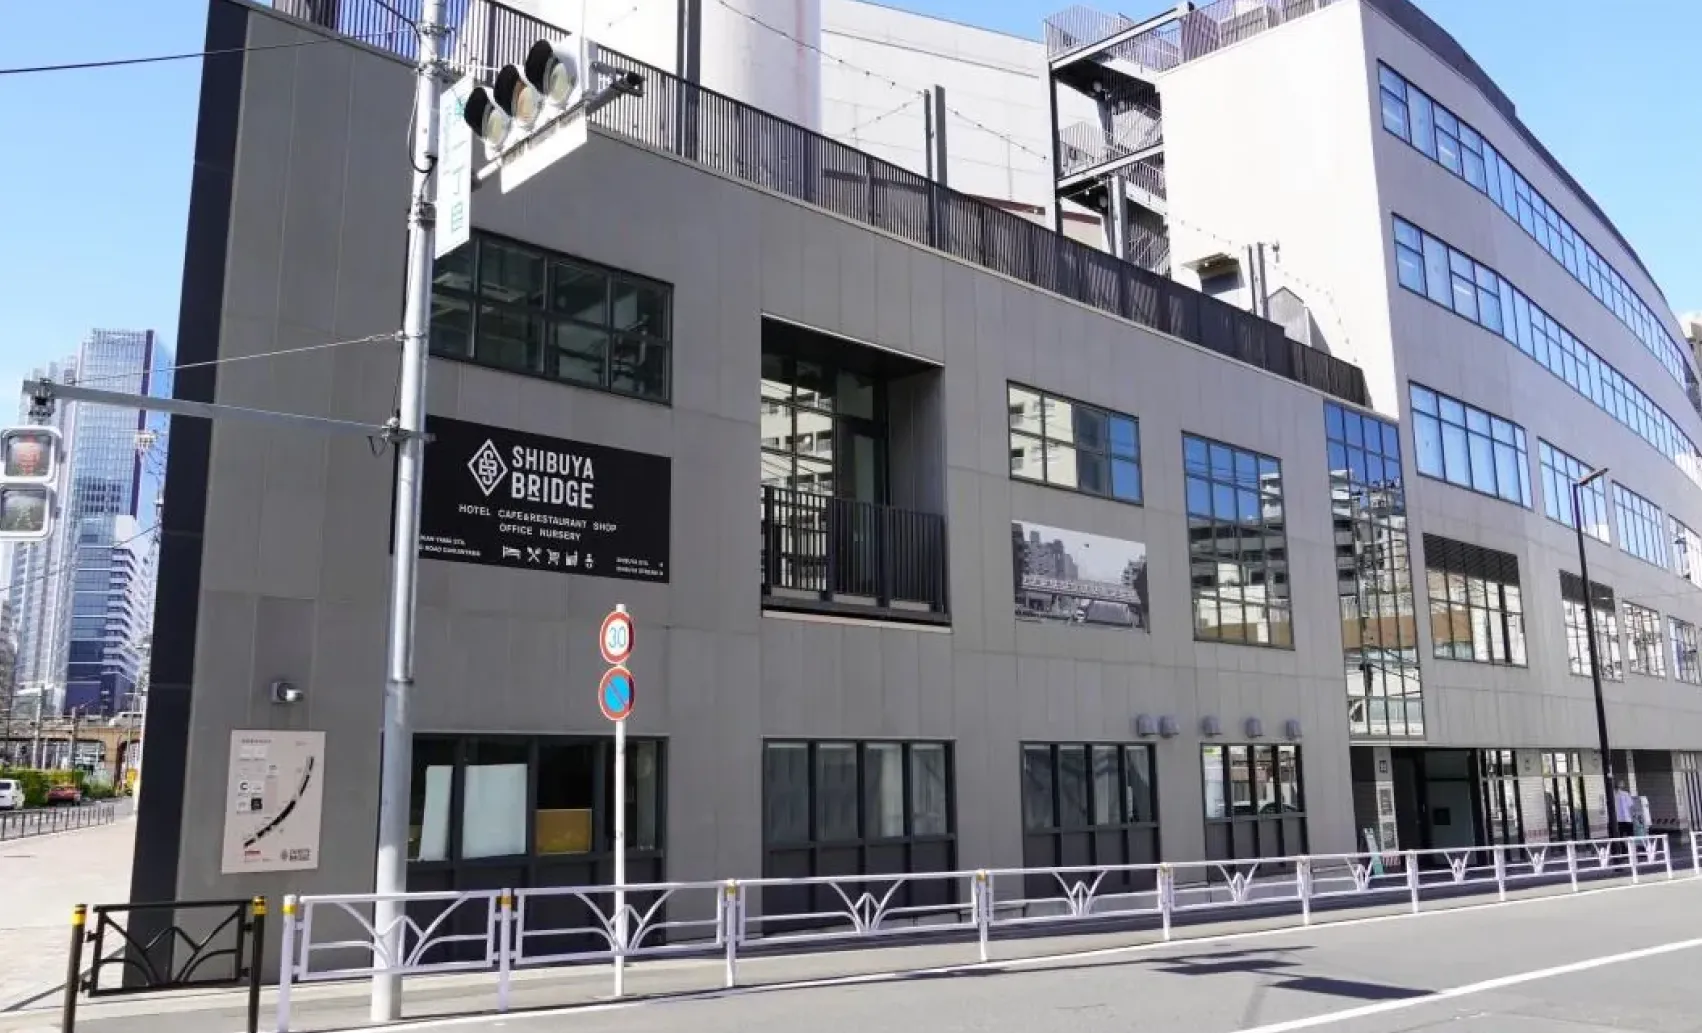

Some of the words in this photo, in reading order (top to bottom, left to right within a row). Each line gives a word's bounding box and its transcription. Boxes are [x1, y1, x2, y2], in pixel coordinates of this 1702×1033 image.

[512, 445, 594, 480] SHIBUYA
[511, 471, 594, 509] BRIDGE
[458, 503, 491, 516] HOTEL
[498, 509, 587, 529] CAFE&RESTAURANT
[592, 521, 617, 532] SHOP
[499, 522, 533, 535] OFFICE
[539, 528, 582, 541] NURSERY
[608, 626, 627, 649] 30
